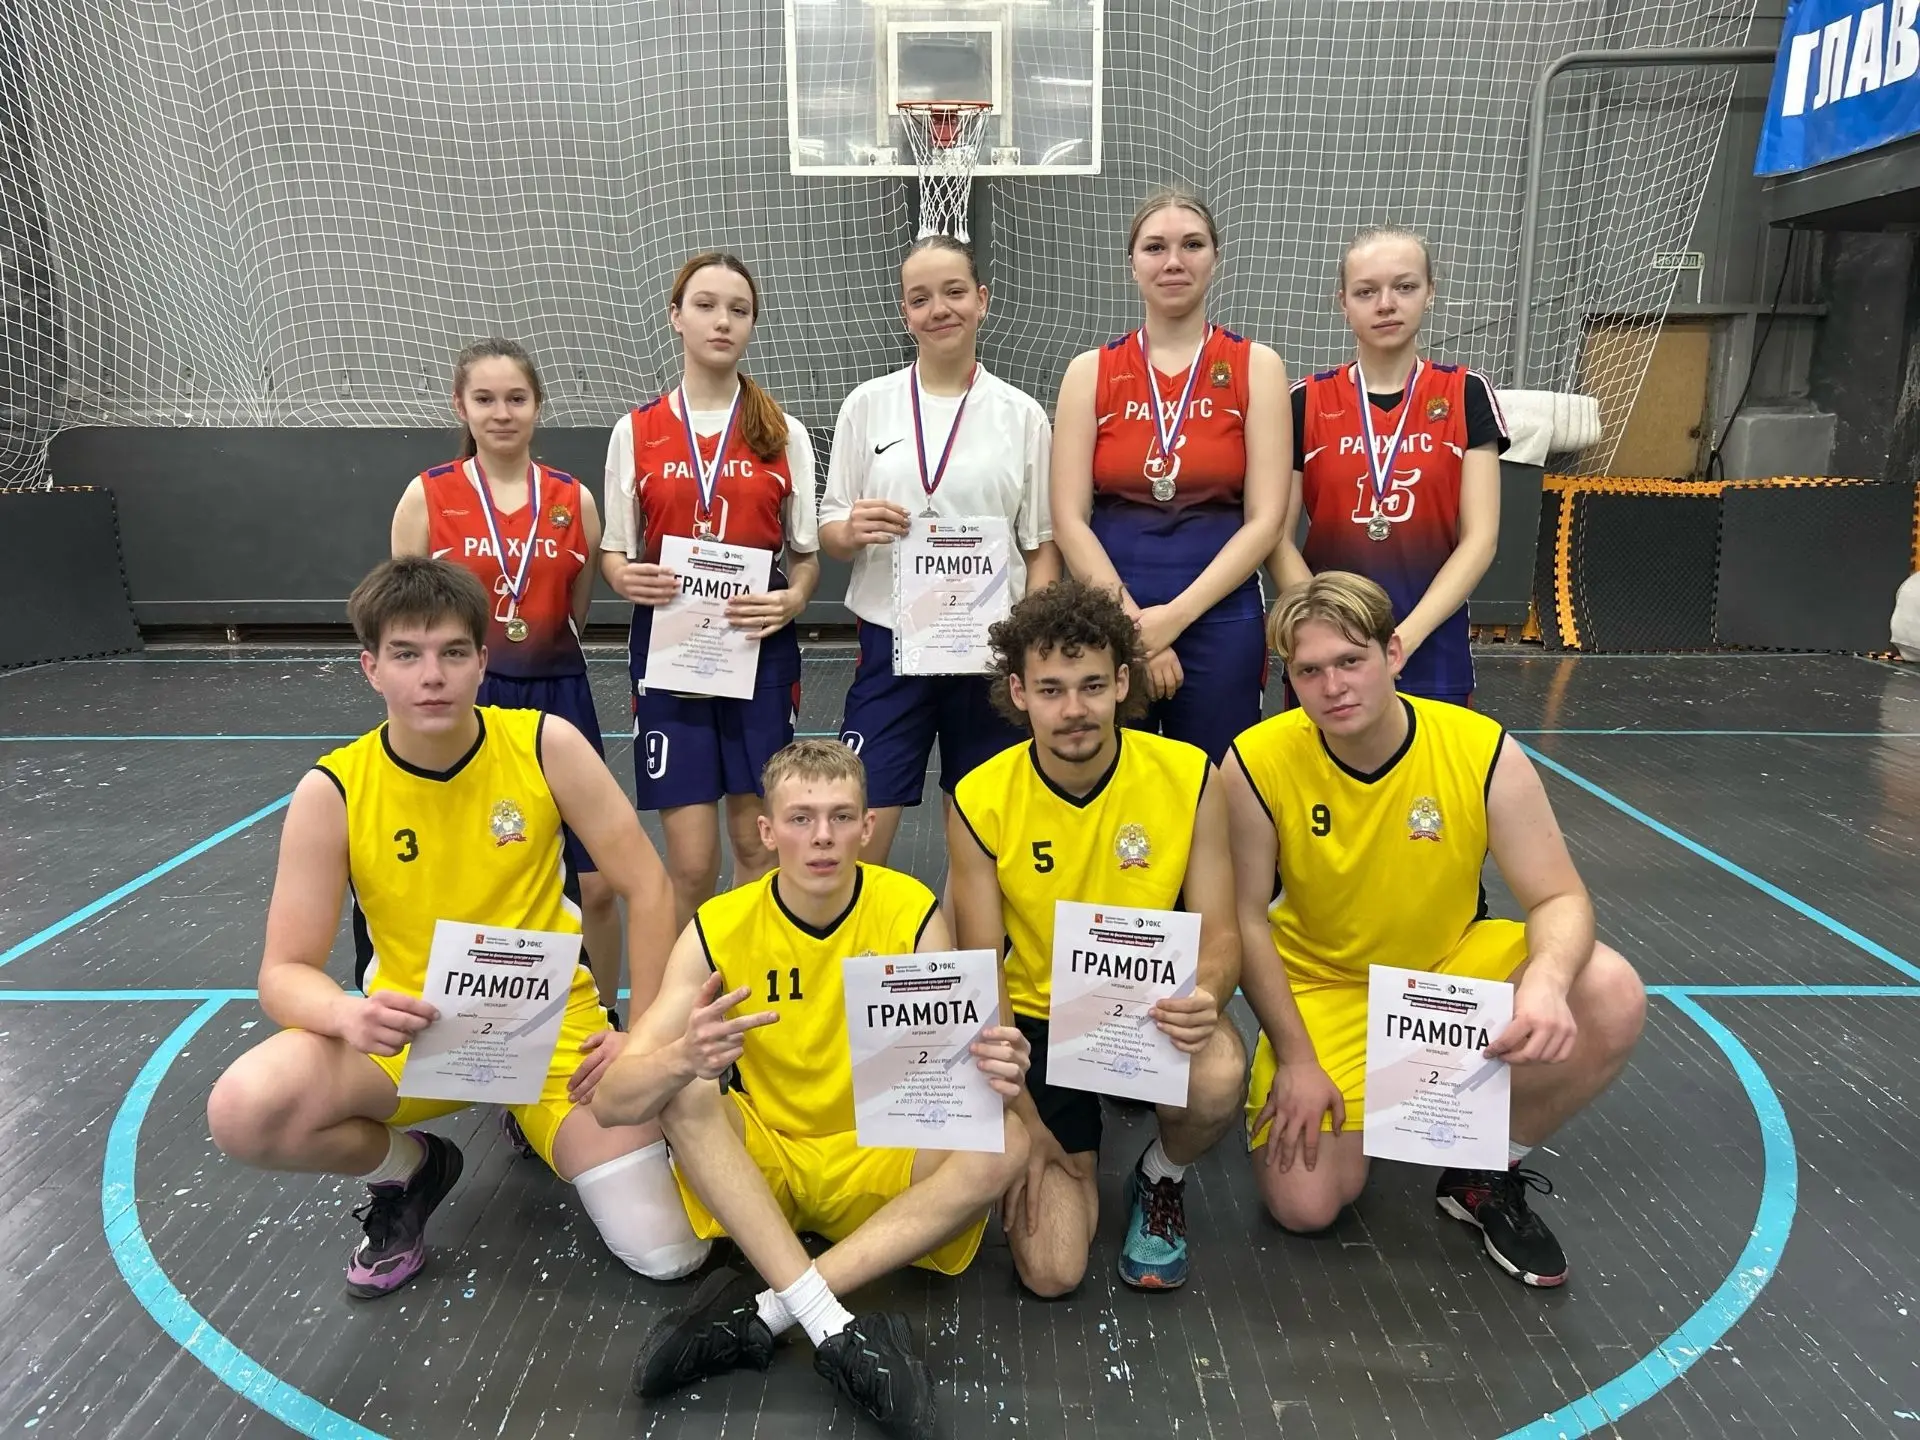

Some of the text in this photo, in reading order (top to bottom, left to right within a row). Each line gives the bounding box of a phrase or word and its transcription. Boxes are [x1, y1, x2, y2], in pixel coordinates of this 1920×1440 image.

[1782, 0, 1920, 116] ГЛАВ
[1125, 398, 1213, 420] РАХГС
[663, 460, 753, 479] РАХиГС
[1351, 468, 1421, 523] 15
[464, 537, 557, 558] РАХГС
[916, 556, 993, 575] ГРАМОТА
[949, 595, 957, 606] 2
[702, 618, 711, 629] 2
[646, 730, 669, 780] 9
[1311, 803, 1331, 837] 9
[394, 828, 419, 863] 3
[1032, 840, 1055, 874] 5
[526, 940, 543, 948] УФКС
[1072, 950, 1176, 985] ГРАМОТА
[445, 971, 549, 1001] ГРАМОТА
[766, 968, 803, 1003] 11
[867, 1000, 978, 1028] ГРАМОТА
[1387, 1014, 1489, 1050] ГРАМОТА
